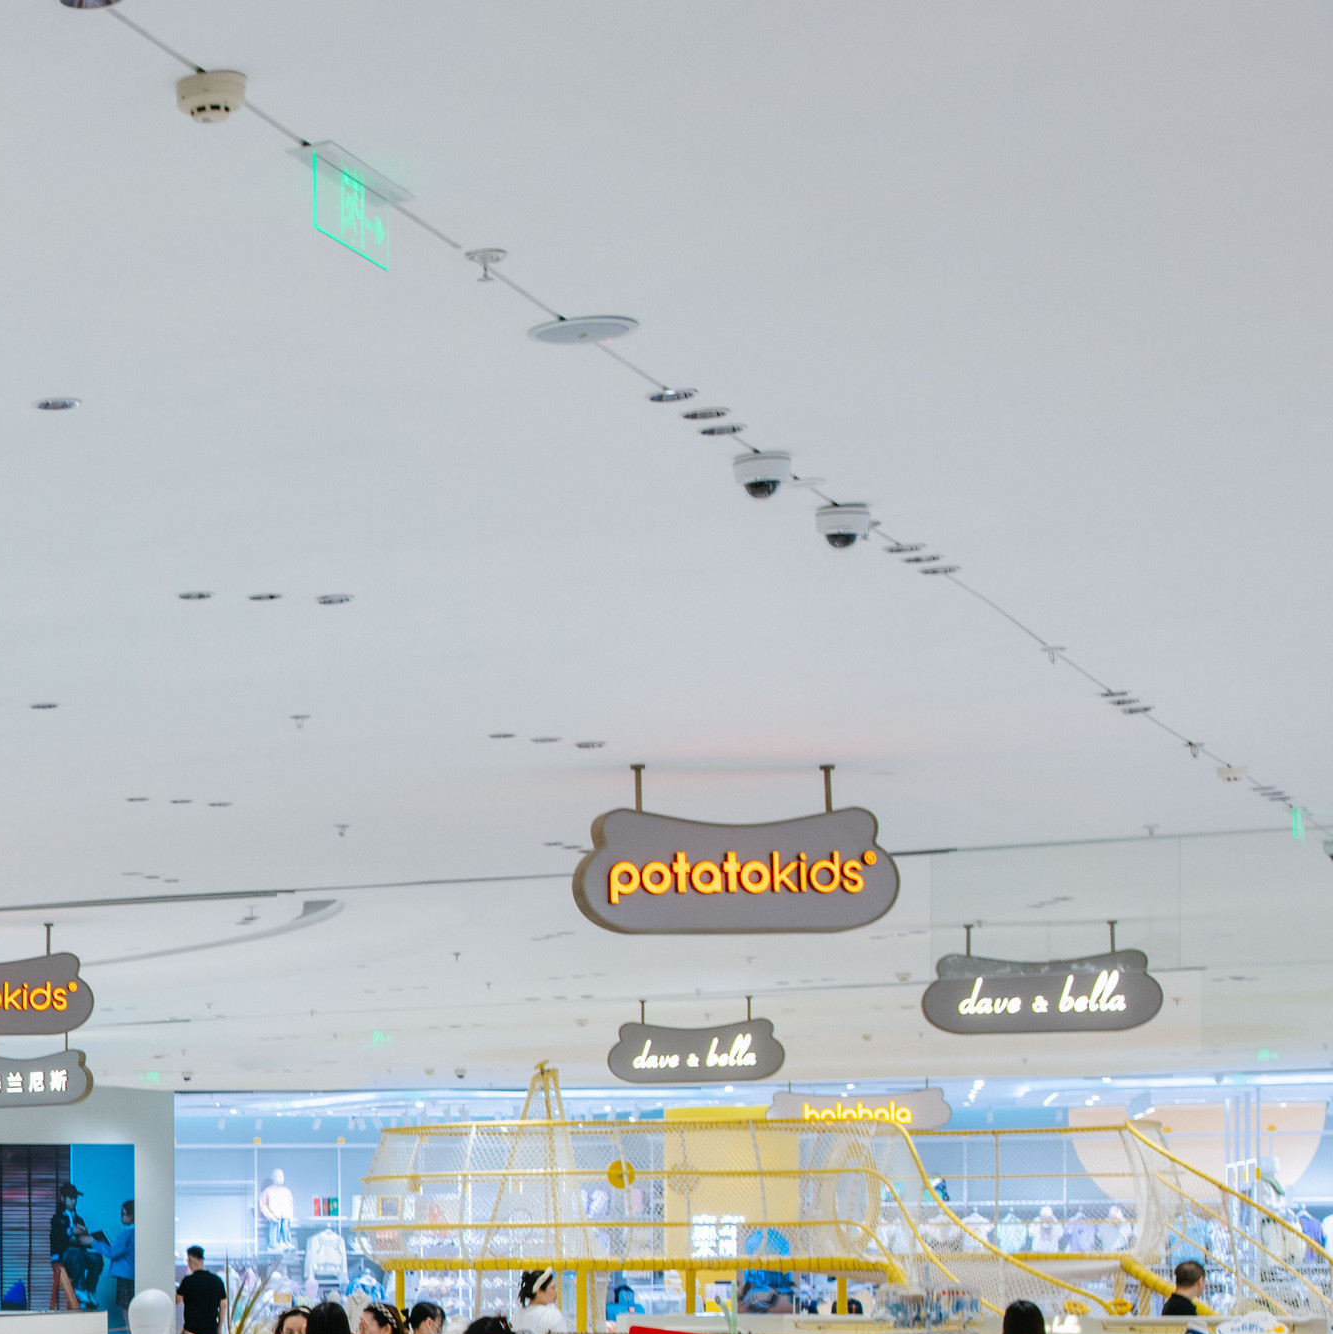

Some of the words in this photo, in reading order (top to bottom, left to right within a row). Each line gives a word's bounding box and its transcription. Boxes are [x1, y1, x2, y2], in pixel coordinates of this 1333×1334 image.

[957, 976, 1022, 1016] dave
[1057, 970, 1127, 1014] bella
[632, 1038, 681, 1070] dave
[705, 1032, 758, 1069] bella
